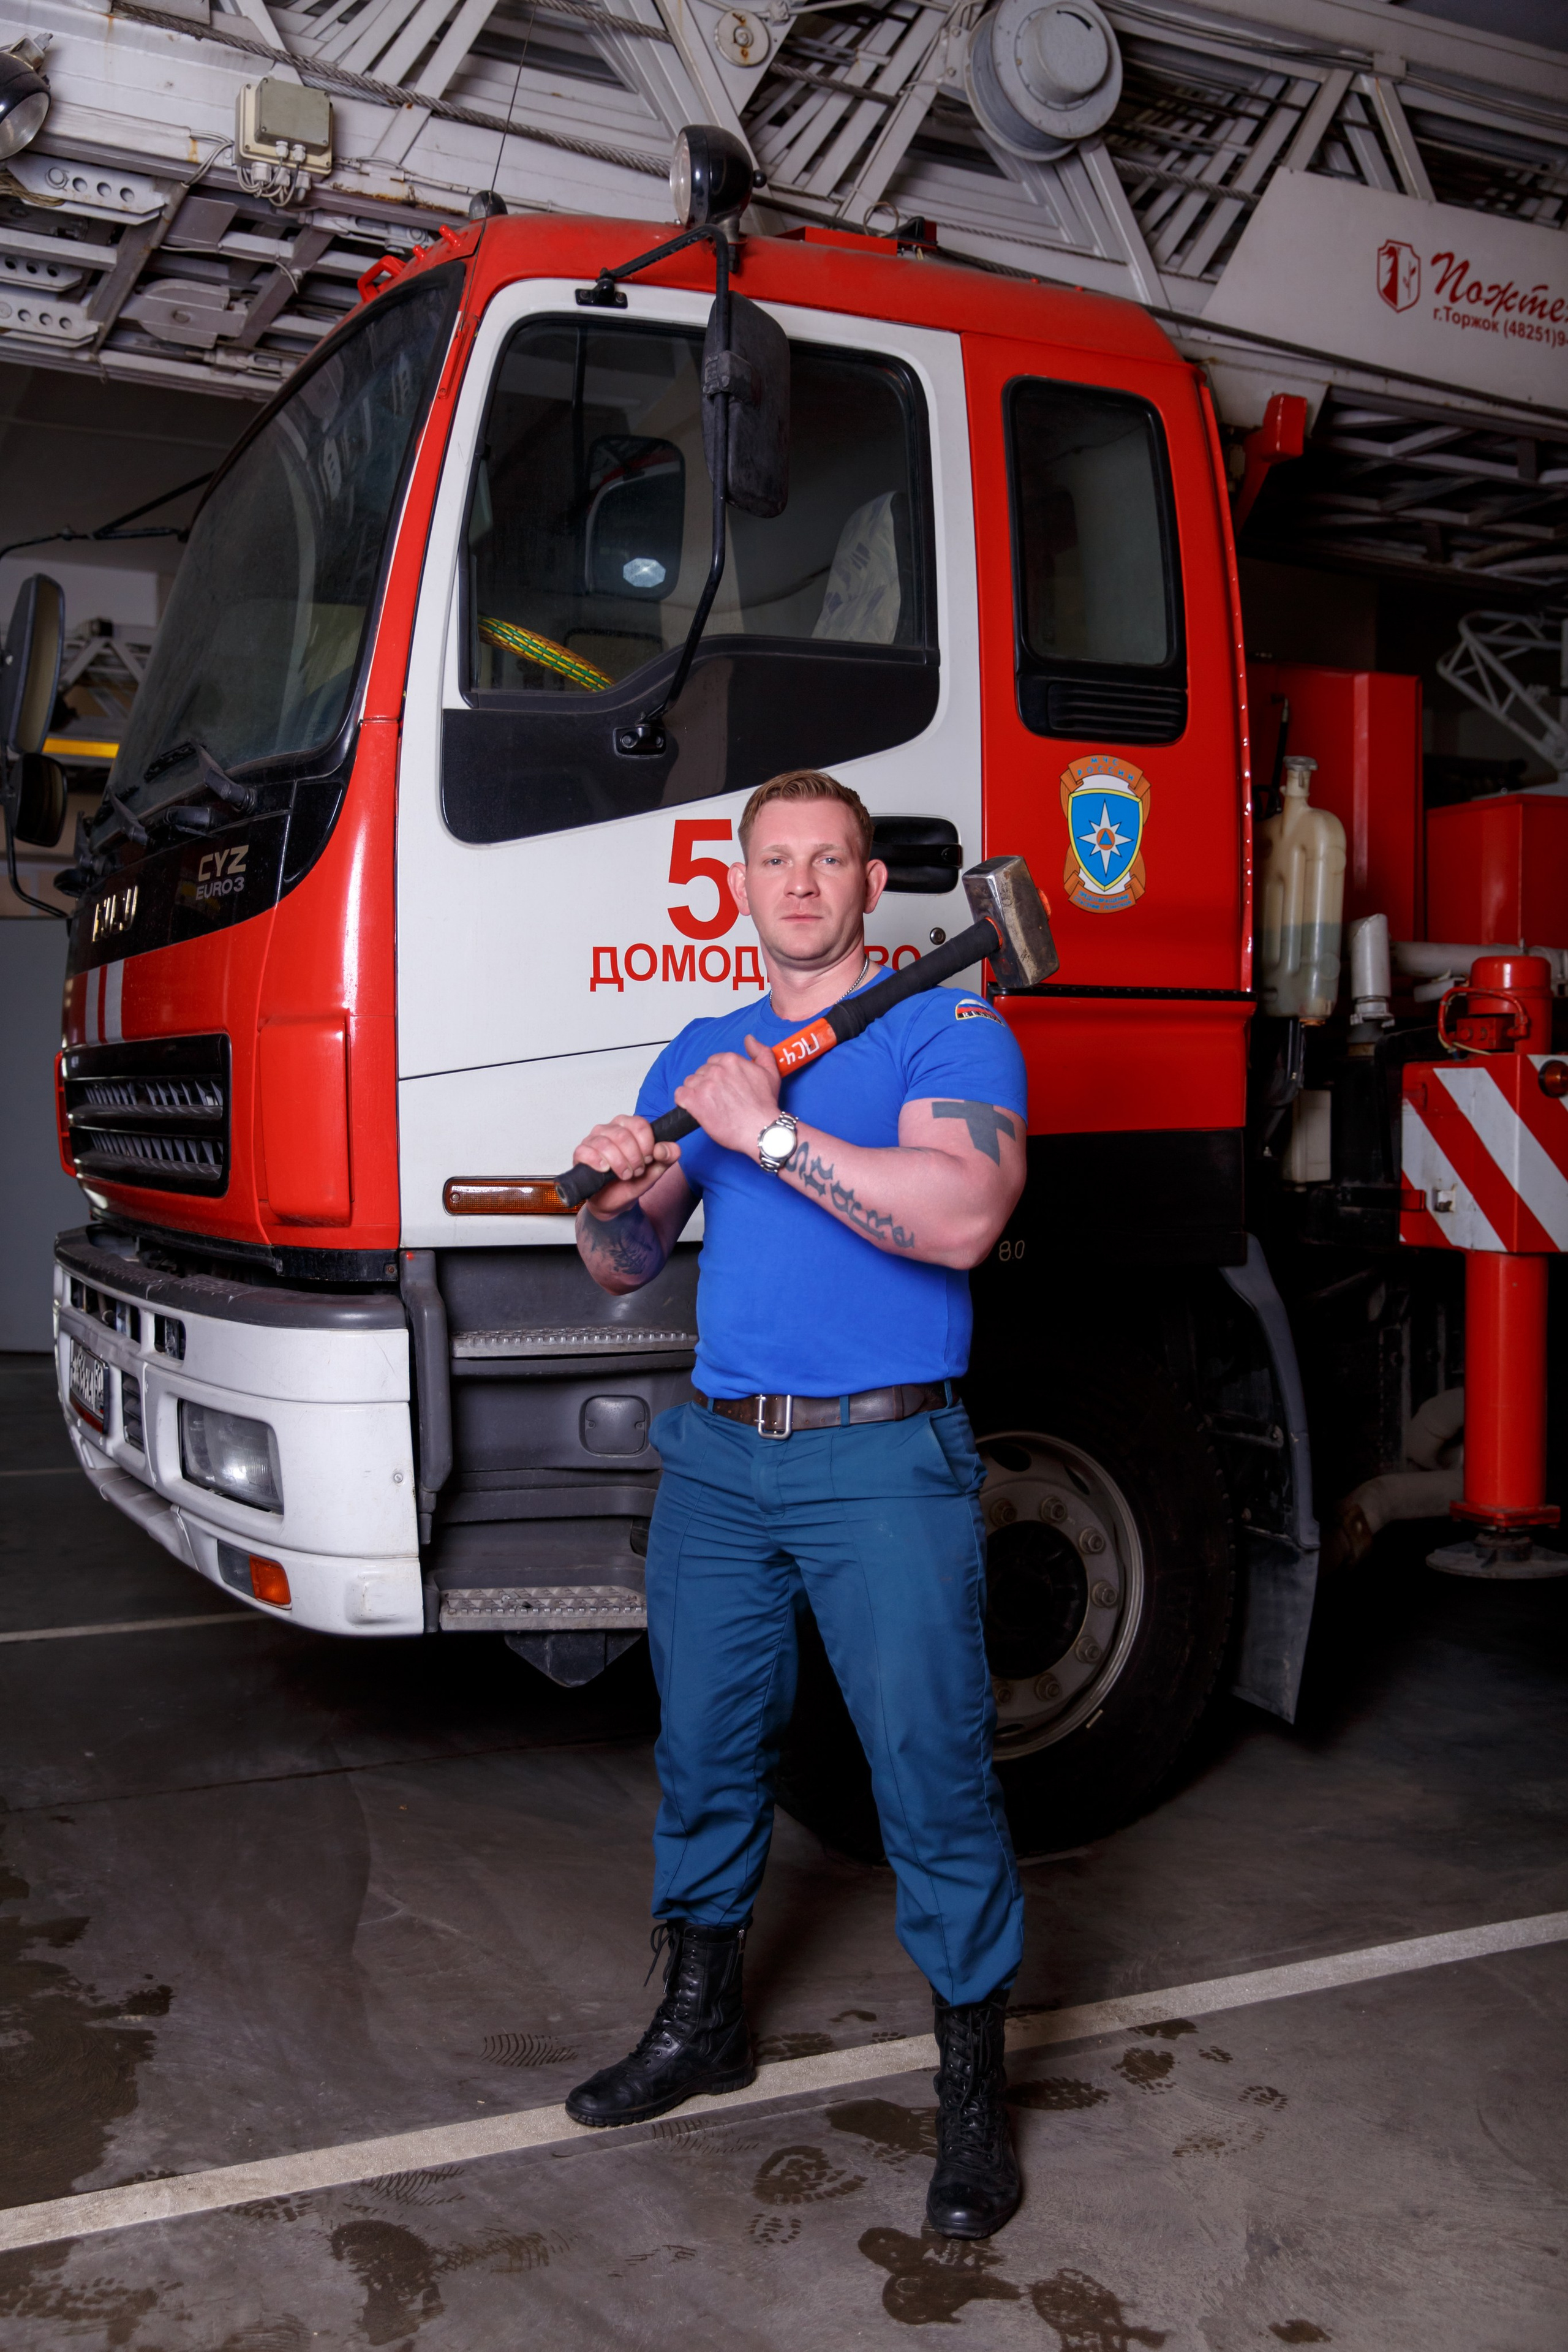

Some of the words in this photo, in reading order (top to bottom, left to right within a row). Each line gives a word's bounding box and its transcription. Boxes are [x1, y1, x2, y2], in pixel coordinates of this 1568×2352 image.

[1431, 251, 1568, 323] Пожте
[1433, 306, 1499, 333] г.Торжок
[1504, 318, 1568, 349] (48251)9
[1077, 765, 1134, 782] РОССИИ
[1091, 756, 1118, 766] МЧС
[198, 845, 249, 882] CYZ
[667, 819, 739, 941] 5
